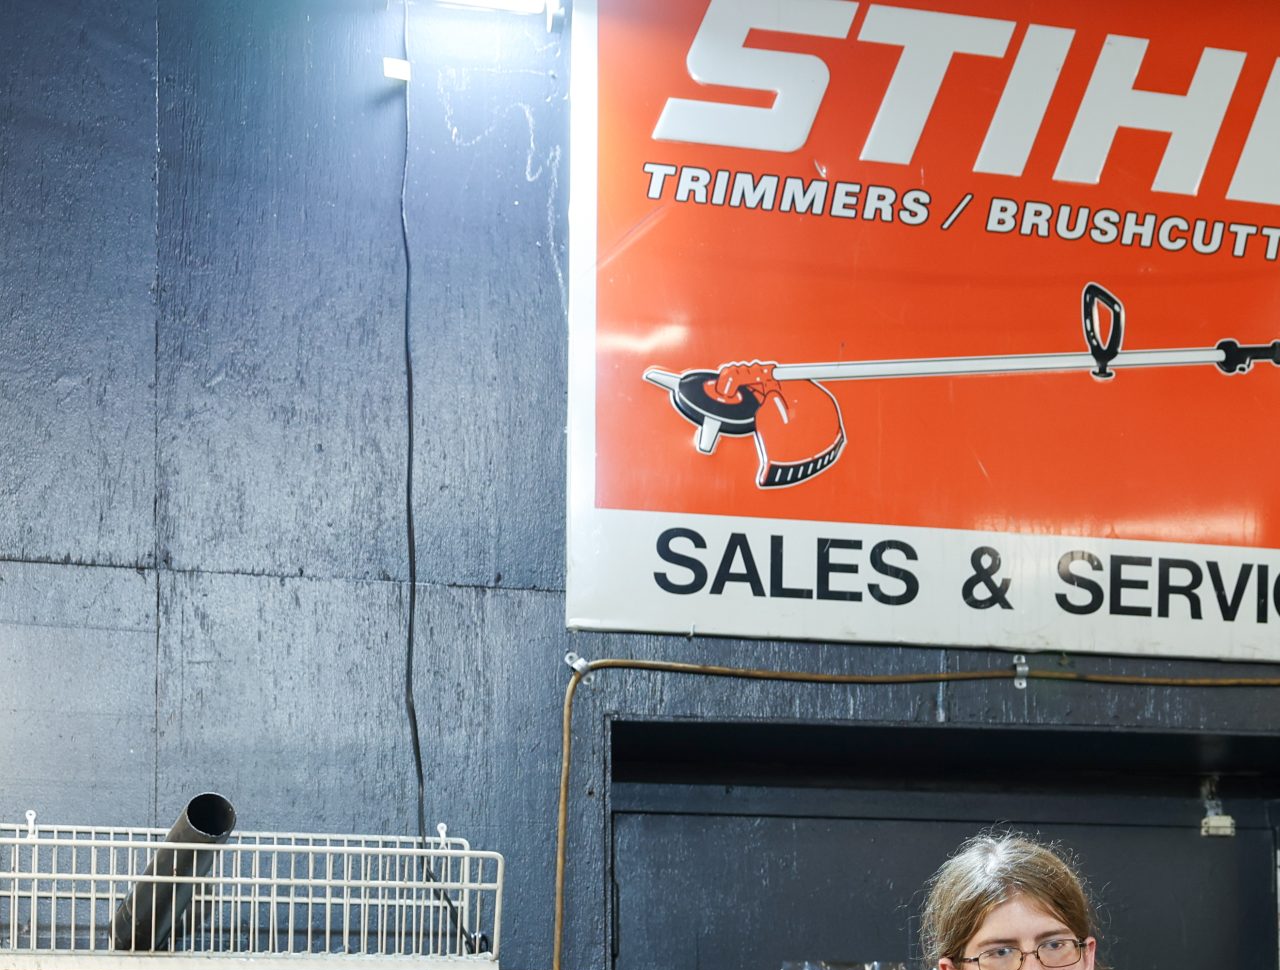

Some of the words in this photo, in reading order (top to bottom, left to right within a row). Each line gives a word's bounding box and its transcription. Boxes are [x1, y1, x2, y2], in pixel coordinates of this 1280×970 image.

[642, 162, 932, 225] TRIMMERS
[940, 194, 974, 230] /
[653, 527, 919, 603] SALES
[961, 546, 1015, 609] &
